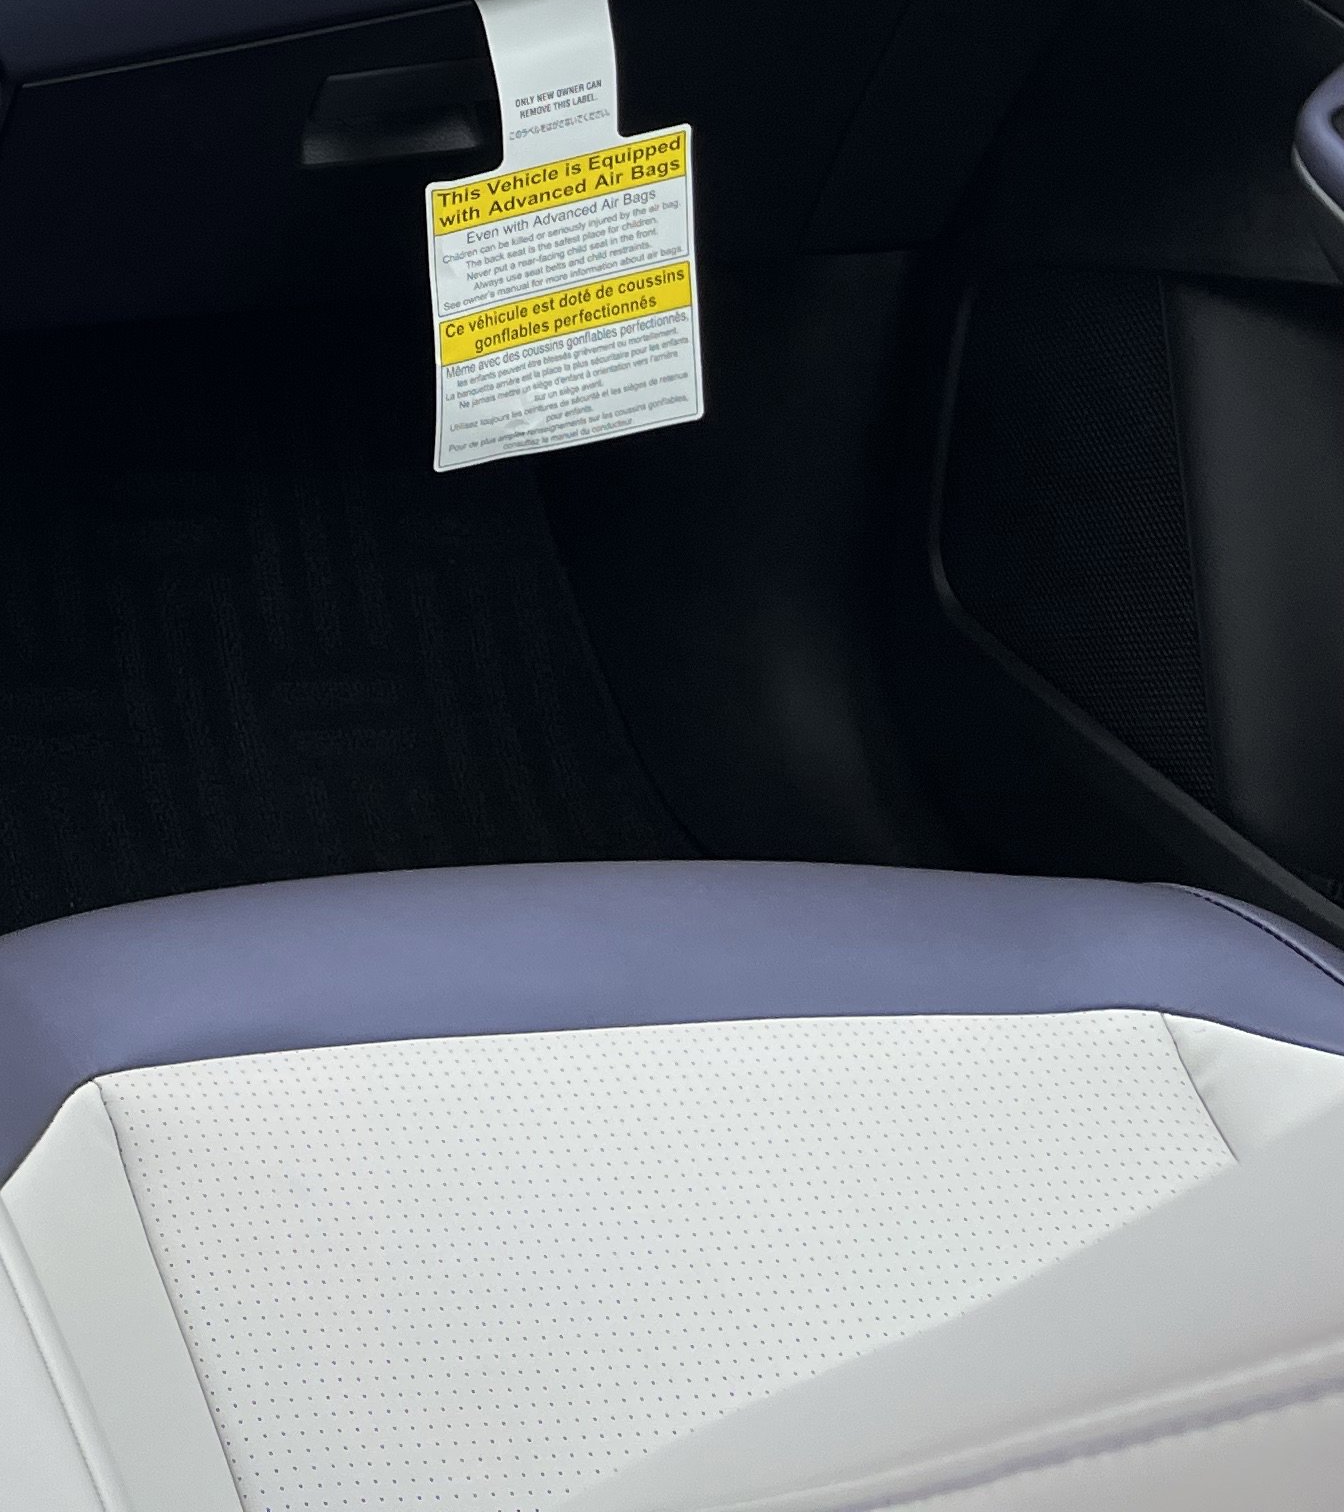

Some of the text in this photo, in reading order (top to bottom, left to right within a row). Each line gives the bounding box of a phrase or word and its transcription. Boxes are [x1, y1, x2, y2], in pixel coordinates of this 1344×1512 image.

[515, 80, 601, 107] ONLY NEW OWNER CAN
[520, 104, 551, 119] REMOVE
[554, 99, 570, 110] THIS
[437, 137, 681, 208] This Vehicle is Equipped
[440, 158, 680, 227] with Advanced Air Bags
[443, 249, 477, 264] Children
[480, 244, 495, 254] can
[498, 241, 509, 249] be
[512, 233, 534, 245] killed
[548, 221, 586, 237] seriously
[588, 214, 617, 227] injured
[620, 212, 630, 220] by
[633, 208, 646, 216] the
[466, 190, 656, 244] Even with Advanced Air Bags
[466, 259, 482, 269] The
[485, 252, 504, 262] back
[507, 248, 525, 258] seat
[538, 241, 551, 251] the
[555, 234, 580, 248] safest
[583, 229, 605, 242] place
[467, 269, 491, 280] Never
[494, 263, 507, 275] put
[518, 250, 565, 267] rear-facing
[567, 244, 587, 256] child
[589, 240, 608, 249] seat
[611, 237, 618, 245] in
[621, 233, 634, 243] the
[474, 277, 504, 290] Always
[506, 272, 522, 282] use
[525, 267, 543, 278] seat
[546, 262, 566, 273] belts
[569, 257, 584, 267] and
[587, 250, 607, 262] child
[443, 300, 460, 311] See
[463, 290, 495, 305] owner's
[498, 282, 529, 296] manual
[532, 277, 543, 285] for
[546, 273, 568, 285] more
[570, 258, 618, 278] information
[620, 253, 645, 266] about
[647, 251, 658, 260] air
[445, 269, 685, 338] Ce véhicule est doté de coussins
[475, 294, 657, 353] gonflables perfectionnés
[446, 361, 476, 379] Même
[478, 357, 501, 371] avec
[503, 350, 520, 364] des
[522, 339, 564, 359] coussins
[567, 328, 618, 349] gonflables
